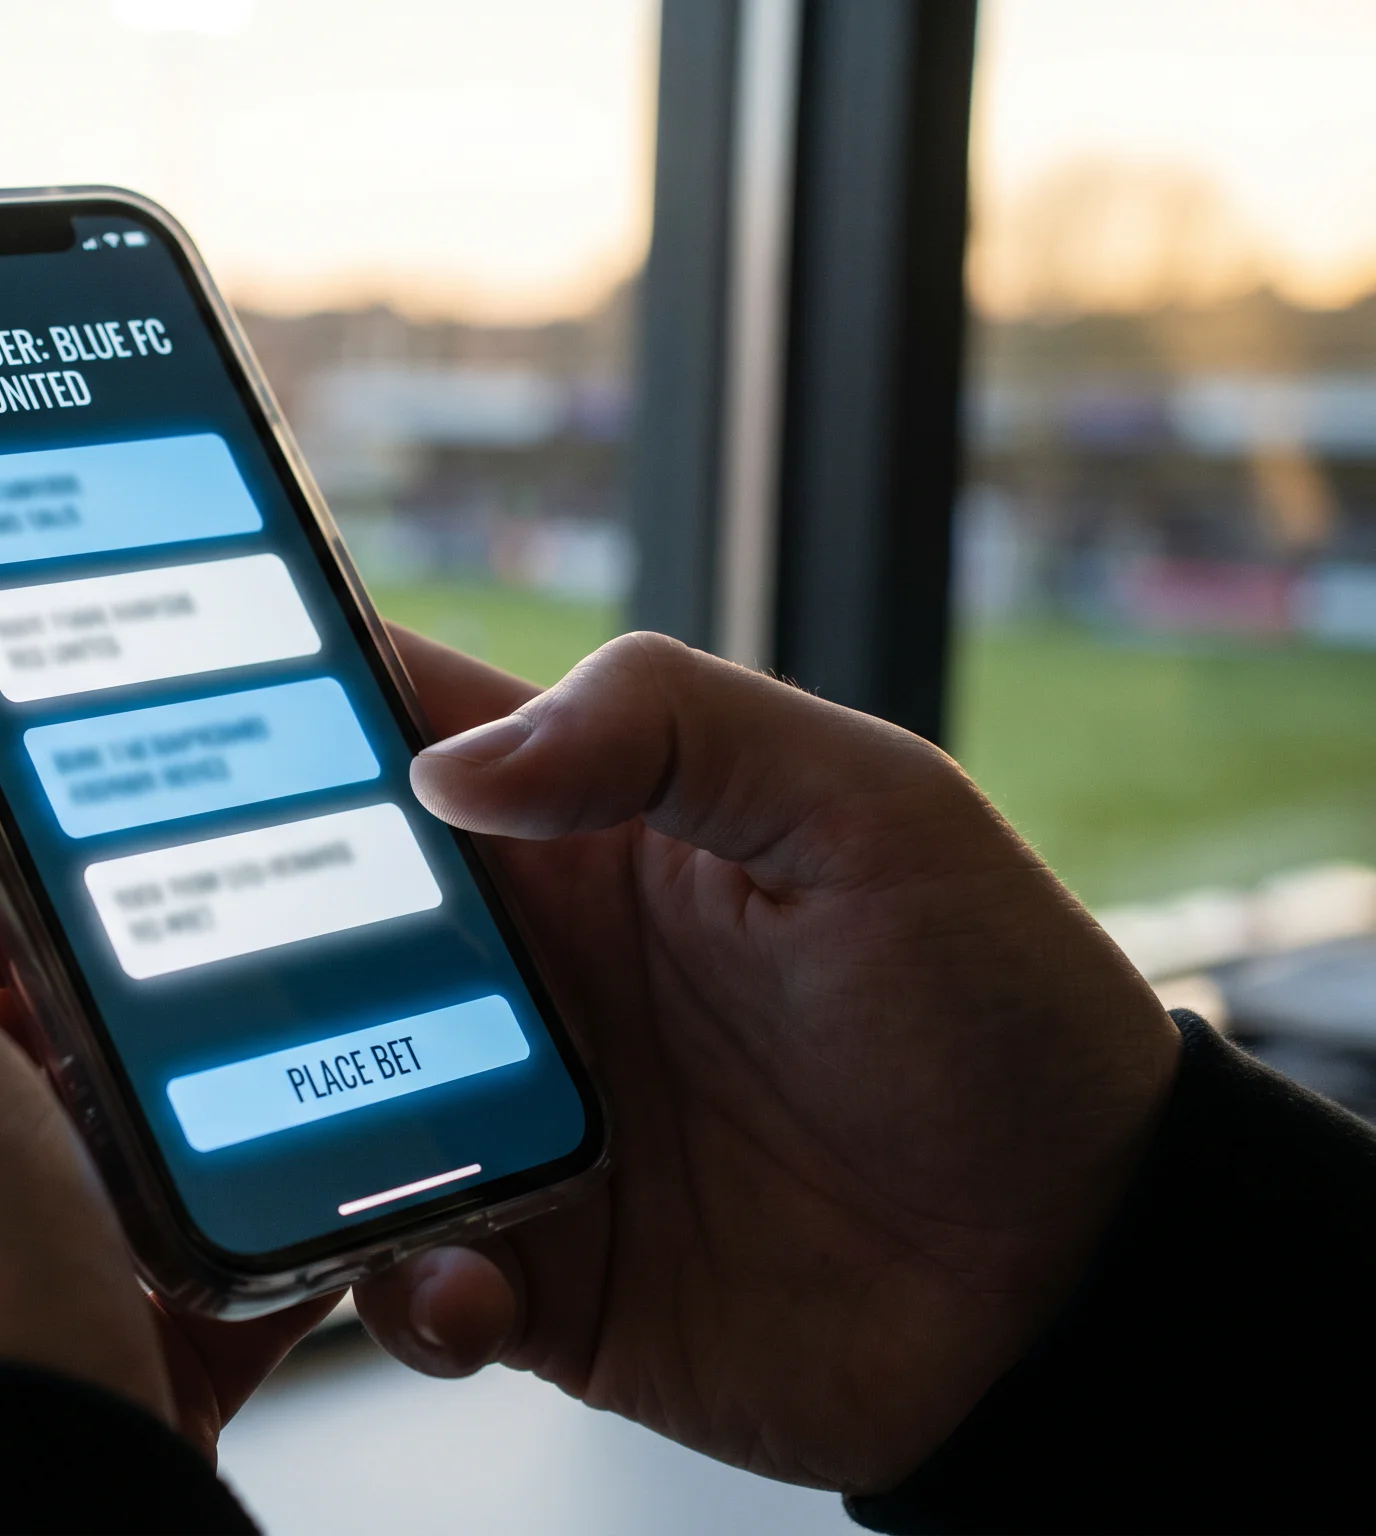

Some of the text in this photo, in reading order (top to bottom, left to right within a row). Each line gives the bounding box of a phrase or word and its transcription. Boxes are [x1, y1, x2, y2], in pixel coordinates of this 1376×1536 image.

[49, 321, 131, 363] BLUE
[127, 318, 173, 356] FC
[286, 1035, 422, 1103] PLACE BET
